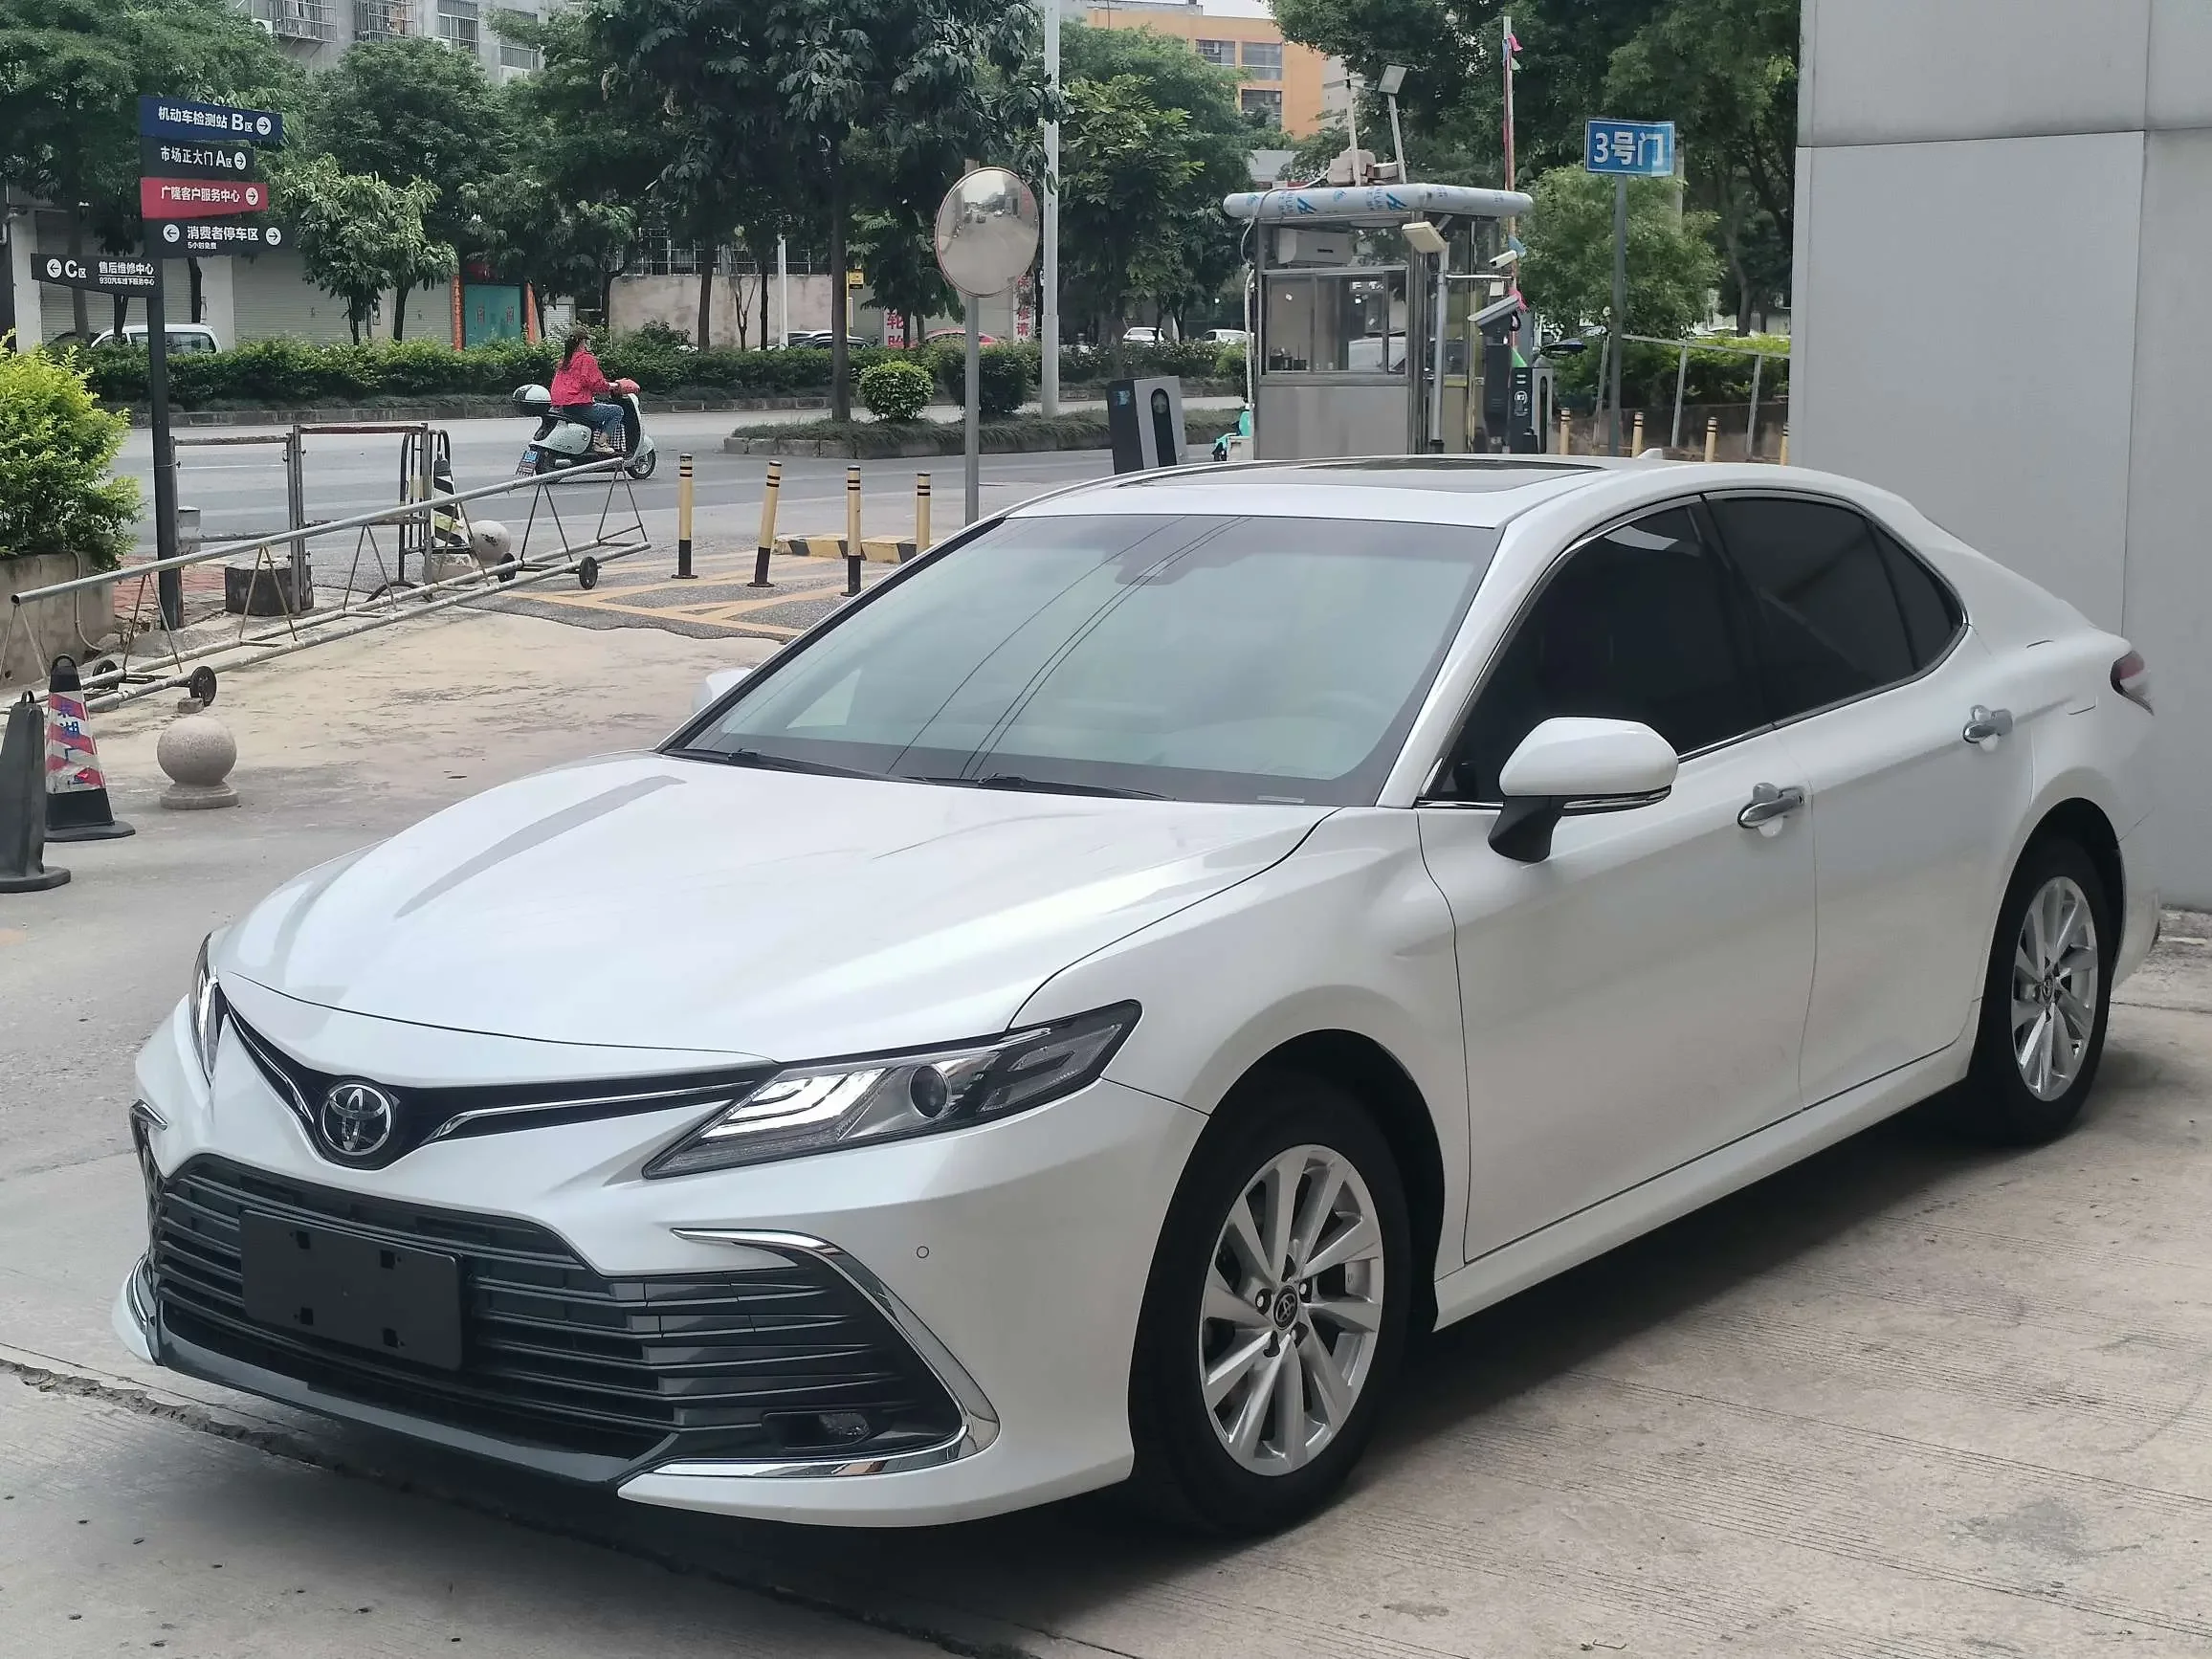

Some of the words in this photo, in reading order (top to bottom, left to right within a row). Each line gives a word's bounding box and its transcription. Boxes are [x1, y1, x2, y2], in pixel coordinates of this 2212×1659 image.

[158, 106, 228, 129] 机动车检测站
[232, 113, 254, 133] B区
[160, 145, 213, 166] 市场正大门
[215, 150, 232, 168] A区
[1593, 131, 1664, 166] 3号门
[161, 186, 240, 203] 广隆客户服务中心
[187, 226, 259, 241] 消费者停车区
[64, 259, 87, 278] C区
[99, 261, 154, 276] 售后维修中心
